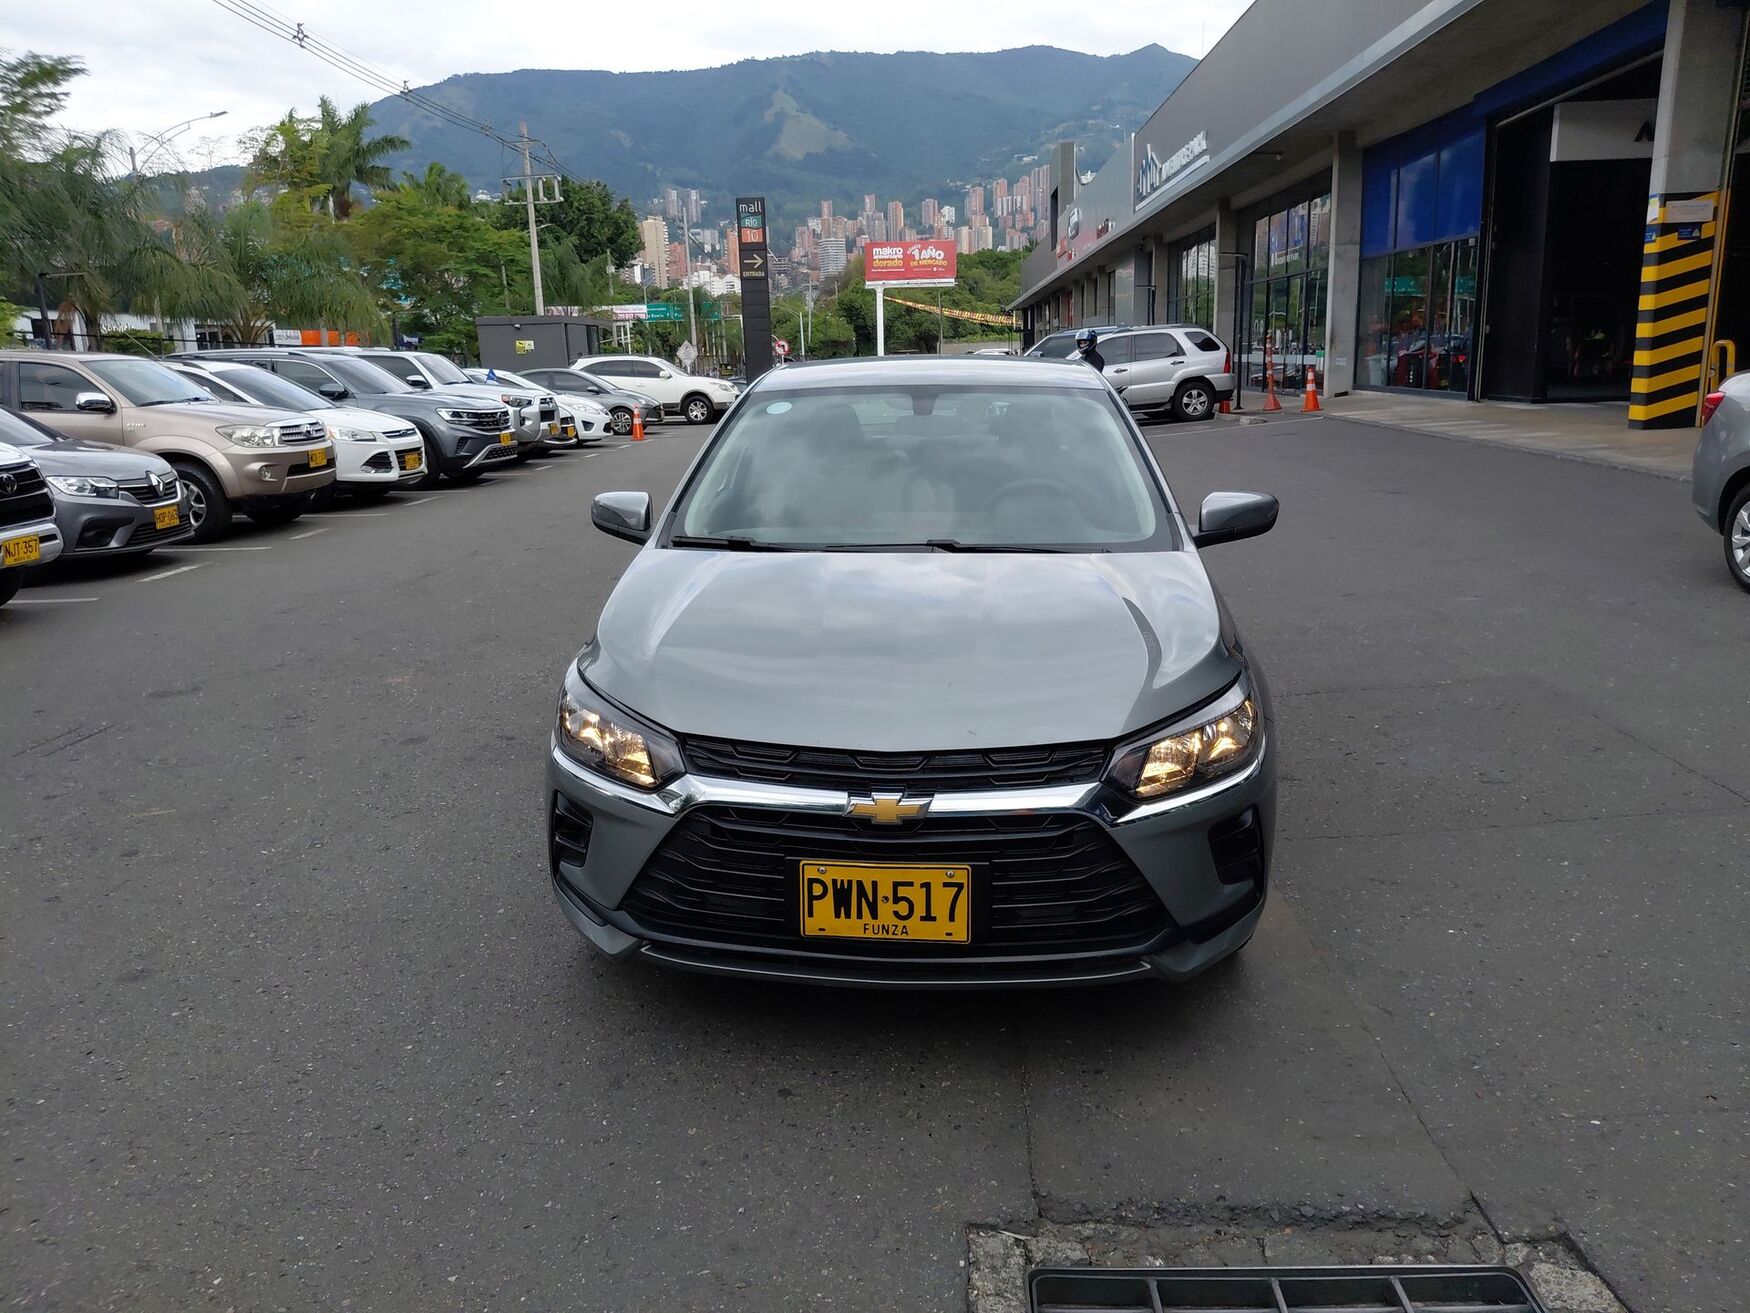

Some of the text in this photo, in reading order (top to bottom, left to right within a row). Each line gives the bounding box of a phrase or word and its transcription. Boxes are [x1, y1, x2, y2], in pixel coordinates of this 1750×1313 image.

[739, 201, 762, 213] mall
[746, 230, 759, 242] 10
[872, 246, 904, 255] makro
[911, 245, 945, 260] 1 AÑO
[872, 258, 904, 267] dorado
[919, 259, 948, 267] MERCADO
[863, 923, 909, 936] FUNZA
